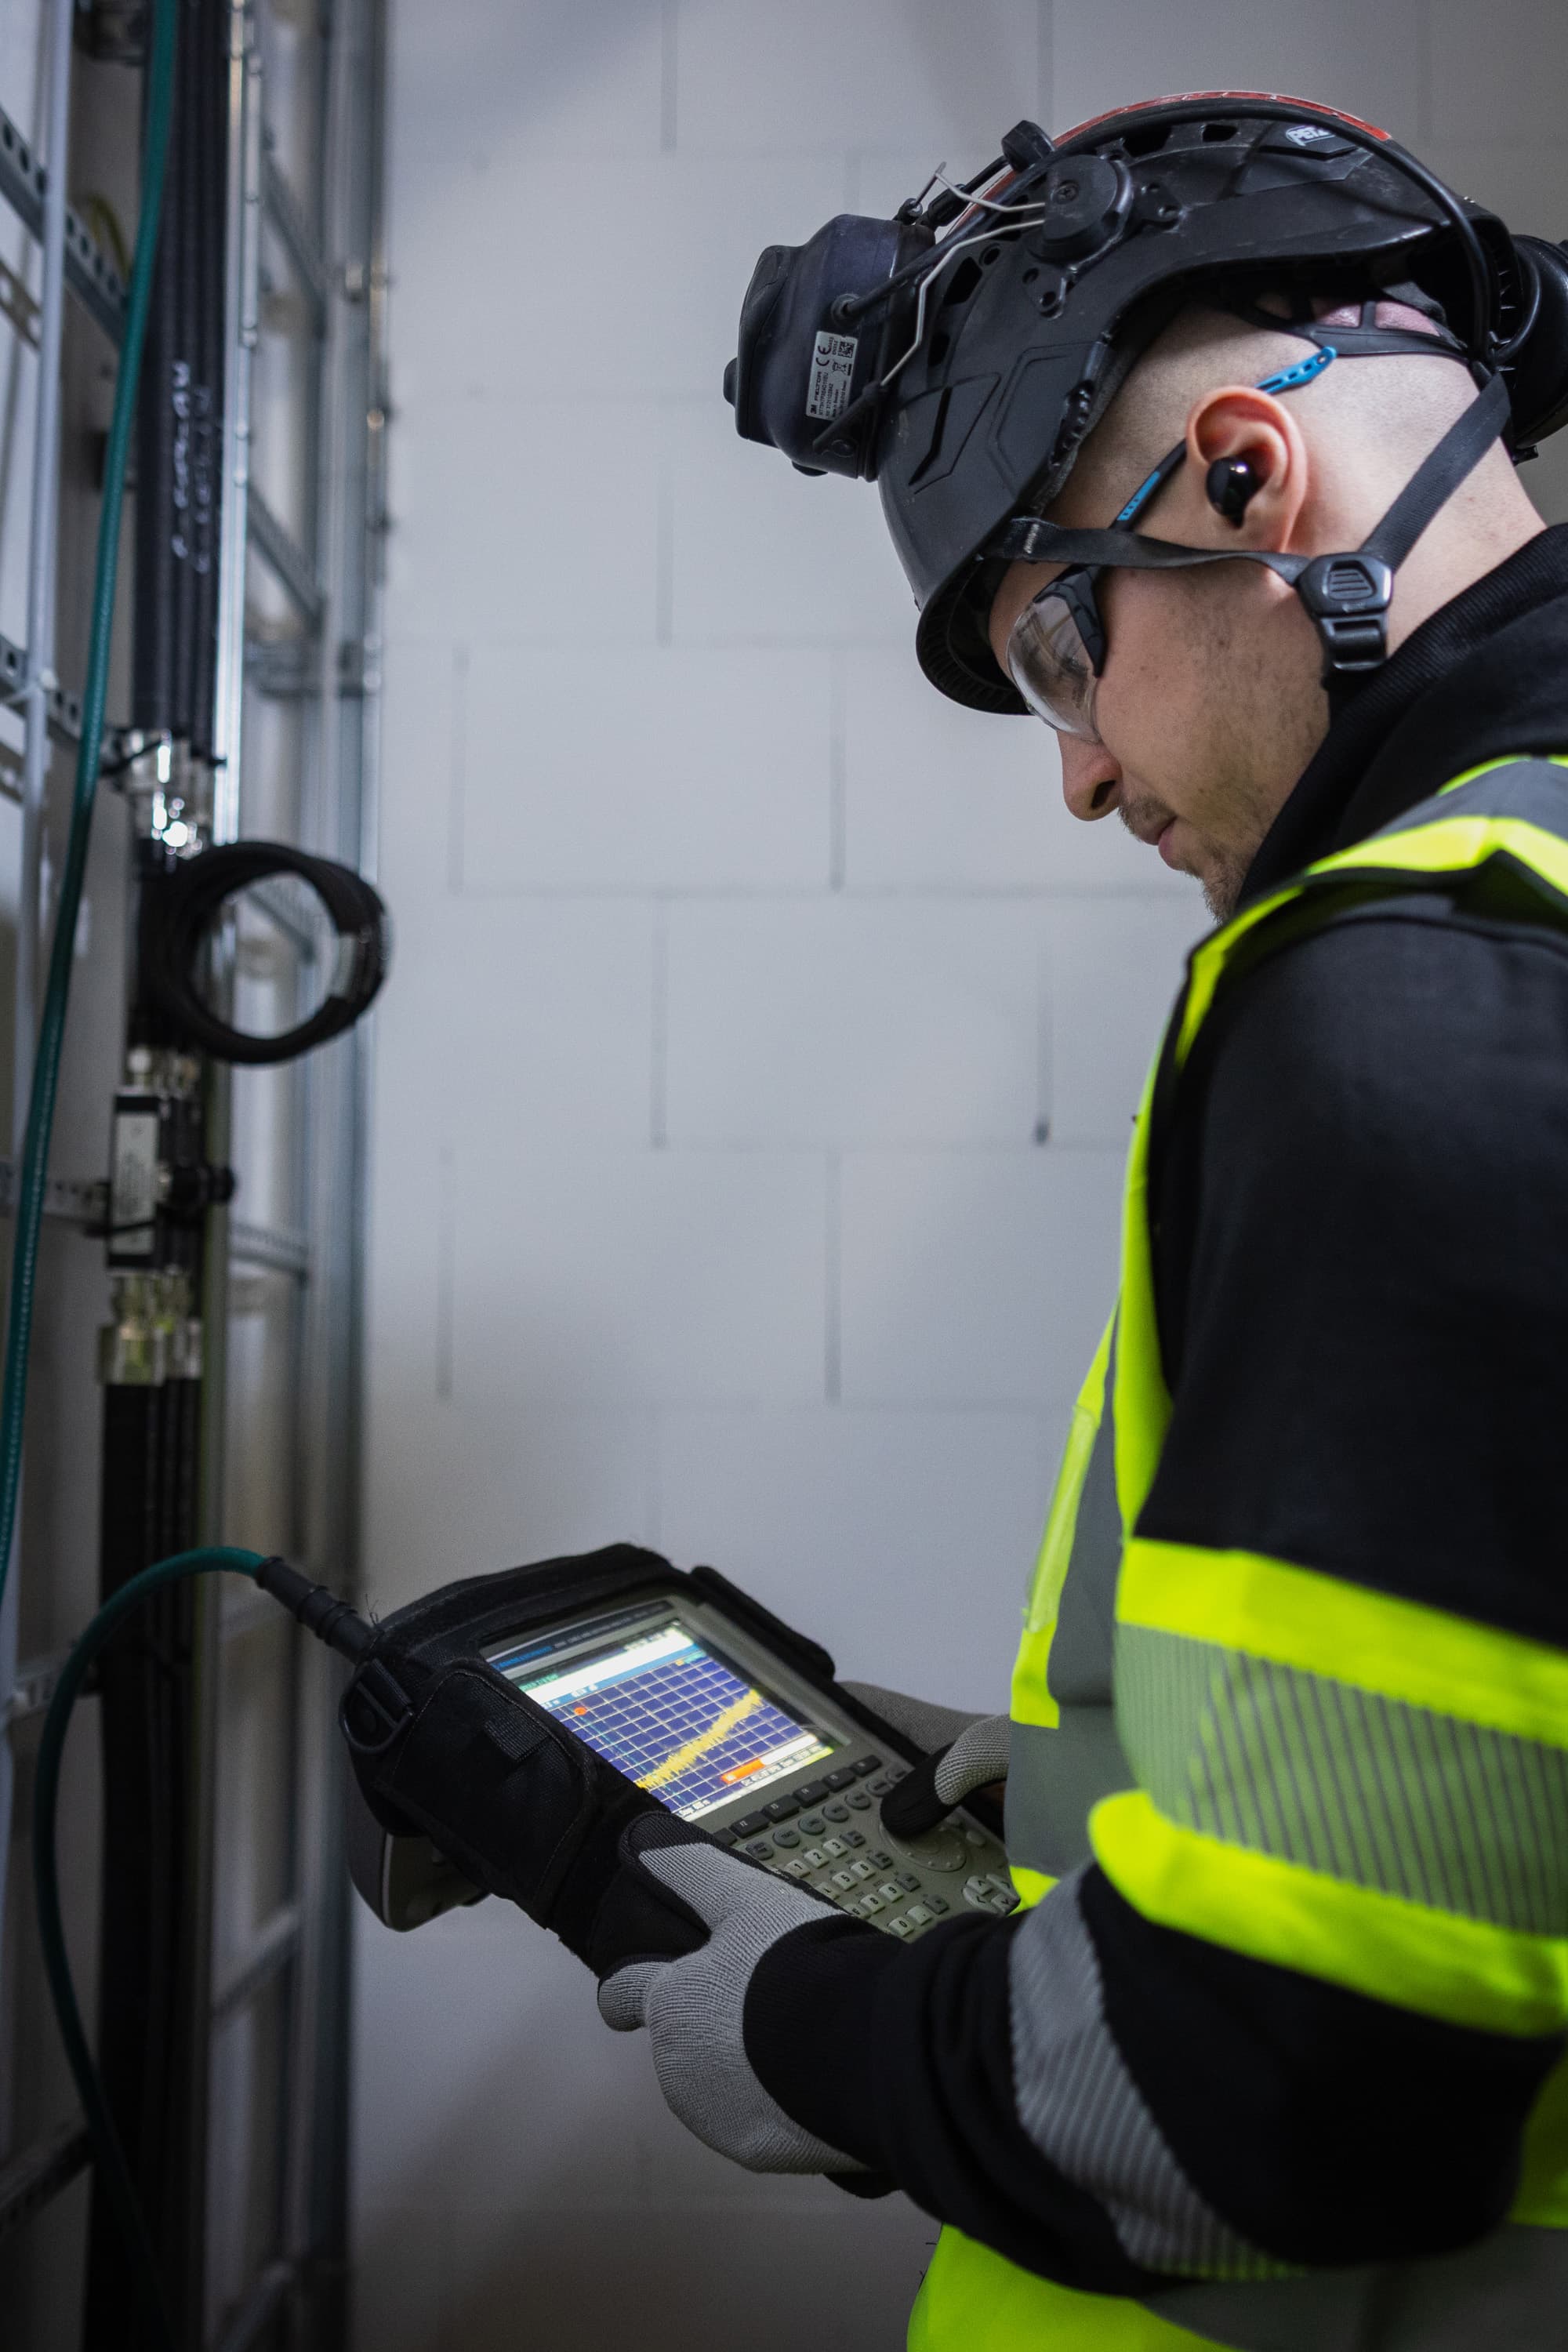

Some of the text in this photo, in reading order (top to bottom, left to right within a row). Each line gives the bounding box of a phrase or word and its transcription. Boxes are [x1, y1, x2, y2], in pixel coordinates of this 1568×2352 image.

[1287, 126, 1332, 147] PETZ
[859, 1863, 869, 1871] 6
[869, 1886, 898, 1905] 8 9
